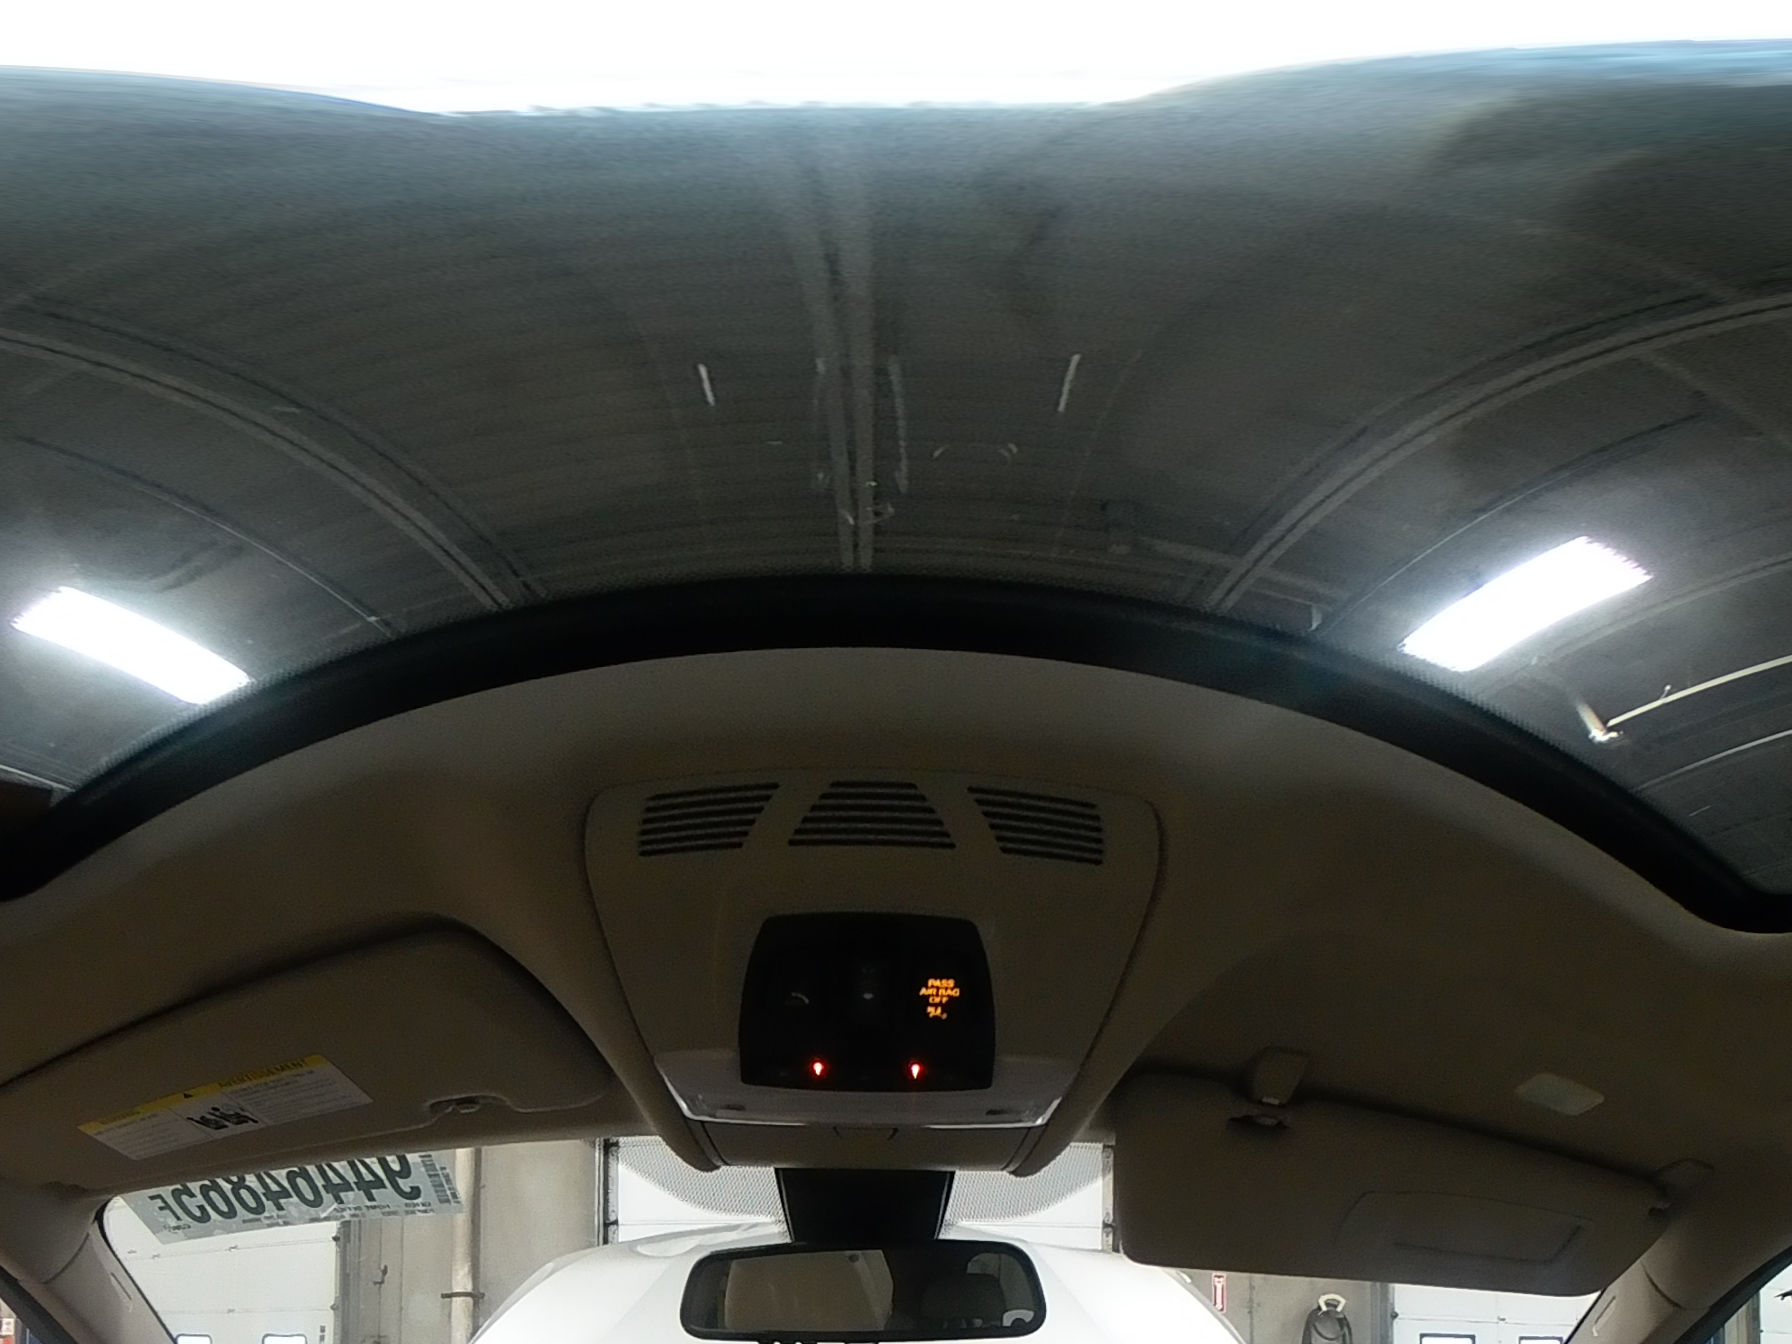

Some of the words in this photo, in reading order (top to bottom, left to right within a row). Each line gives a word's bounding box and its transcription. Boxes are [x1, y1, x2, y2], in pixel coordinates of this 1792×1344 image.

[927, 978, 955, 988] PASS
[919, 987, 937, 996] AIR
[938, 987, 960, 997] BAG
[928, 996, 949, 1004] OFF
